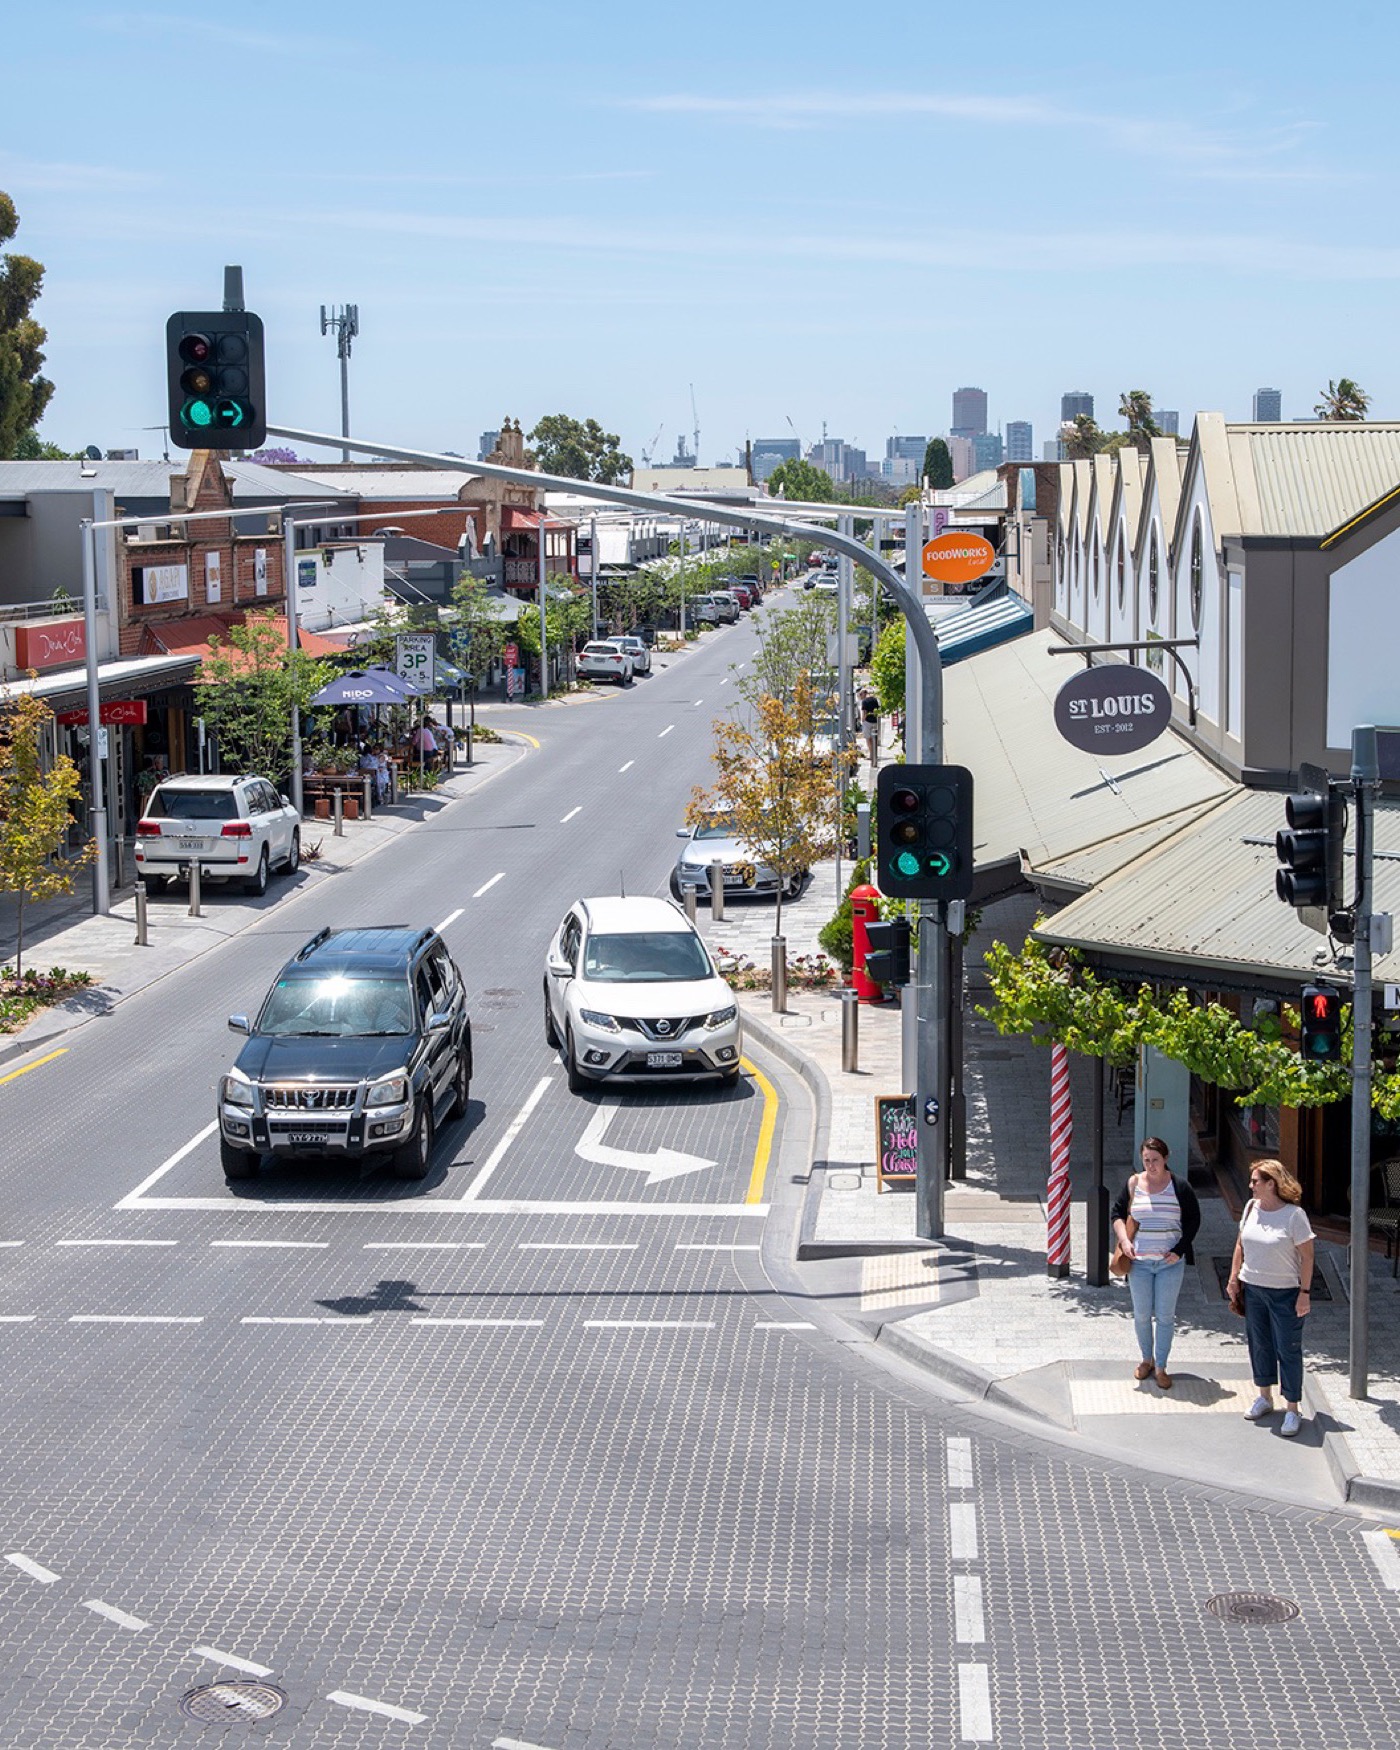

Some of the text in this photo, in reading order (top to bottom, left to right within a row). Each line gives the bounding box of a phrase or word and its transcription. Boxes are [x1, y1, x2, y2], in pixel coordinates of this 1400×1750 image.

[926, 547, 988, 561] FOODWORKS
[403, 653, 427, 668] 3P
[1069, 693, 1156, 718] ST LOUIS
